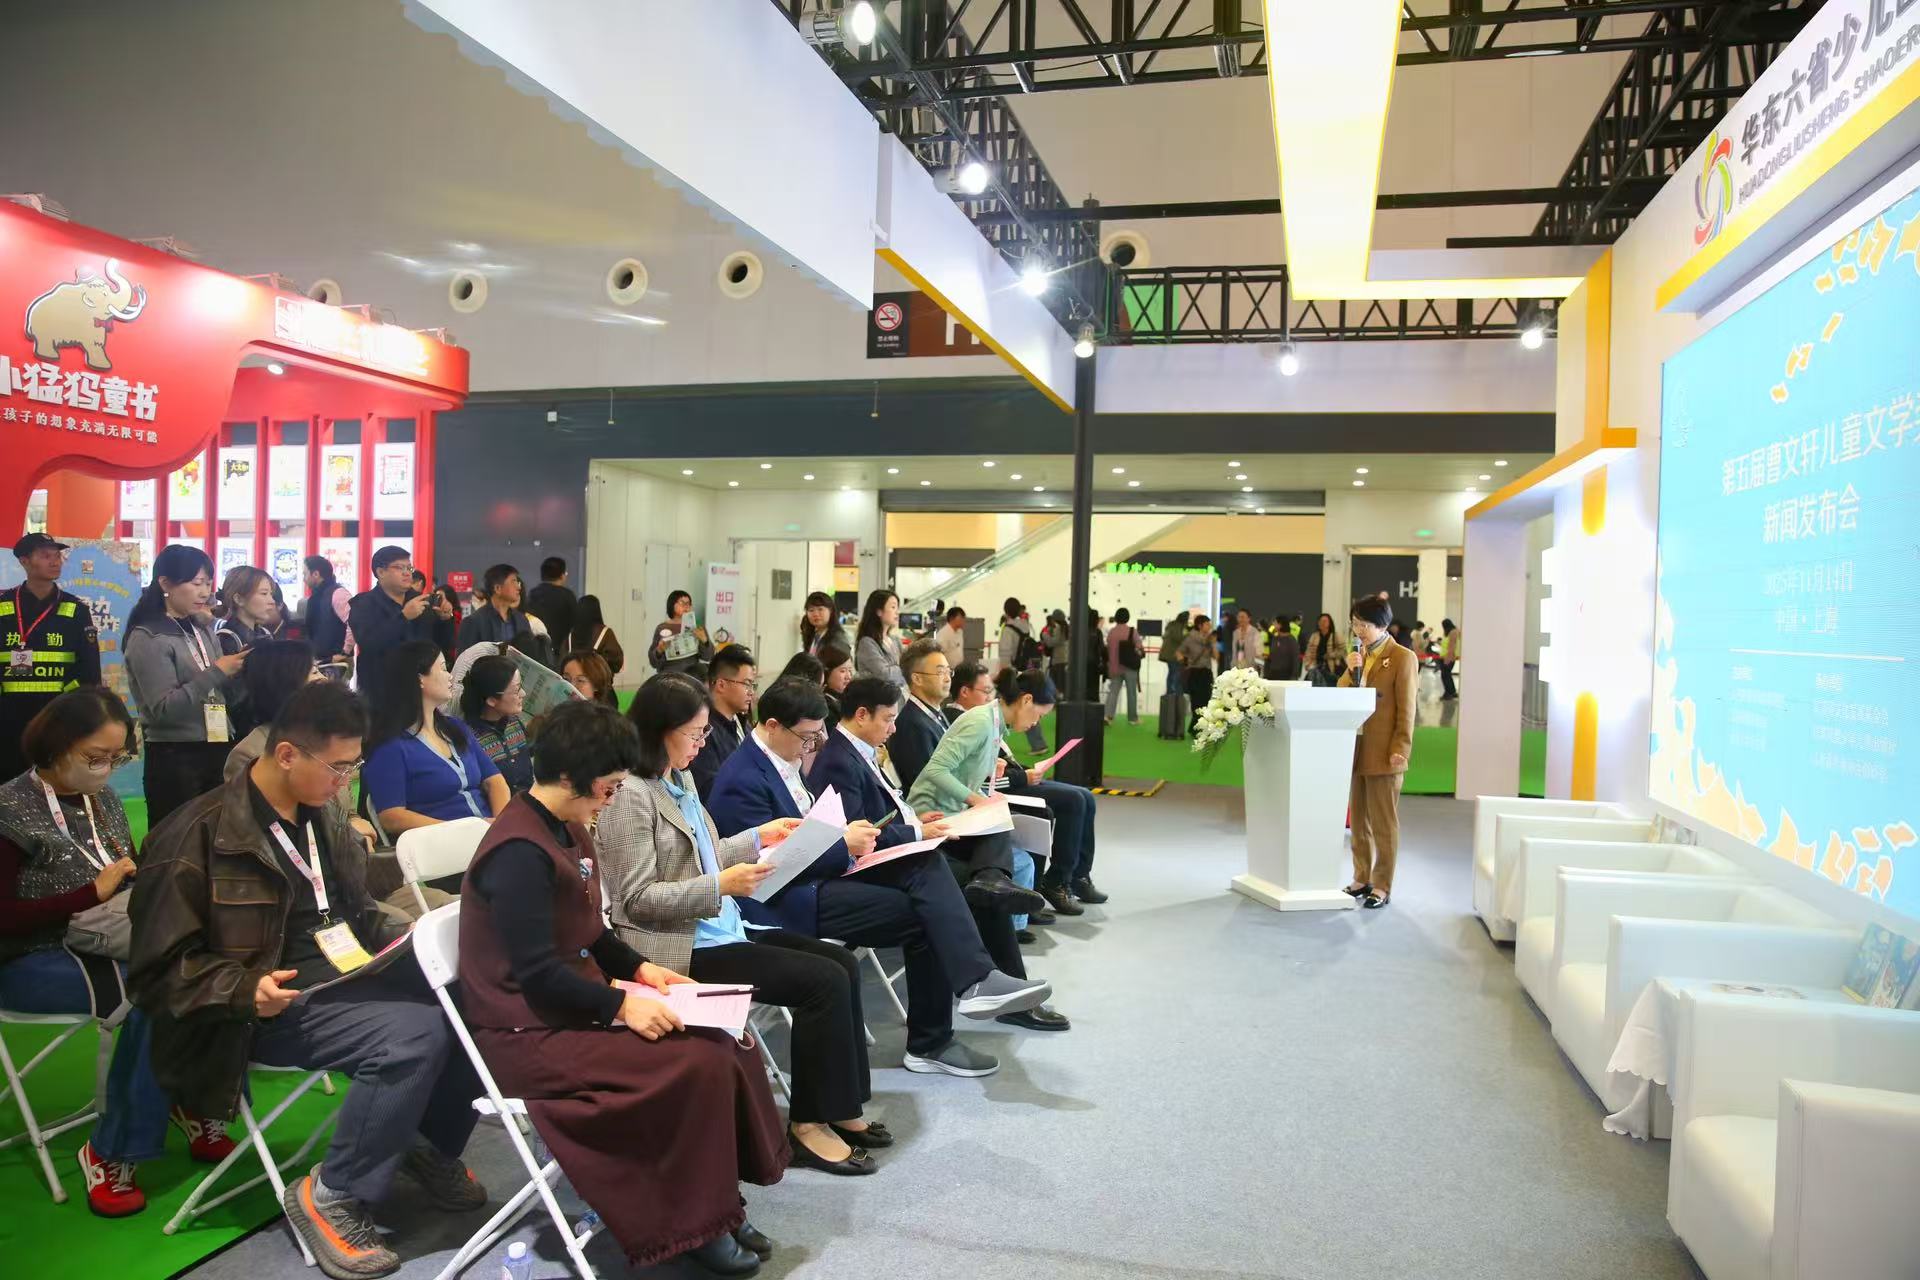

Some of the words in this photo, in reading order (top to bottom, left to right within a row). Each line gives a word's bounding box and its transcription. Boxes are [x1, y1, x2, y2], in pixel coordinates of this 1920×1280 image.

[1741, 0, 1920, 165] 华东六省少儿
[0, 355, 159, 421] 小猛犸童书
[0, 407, 158, 443] 孩子的想象充满无限可能
[1764, 482, 1861, 544] 新闻发布会
[716, 591, 733, 602] 出口
[717, 606, 732, 614] EXIT
[46, 633, 63, 646] 勤
[4, 666, 65, 677] ZQIN
